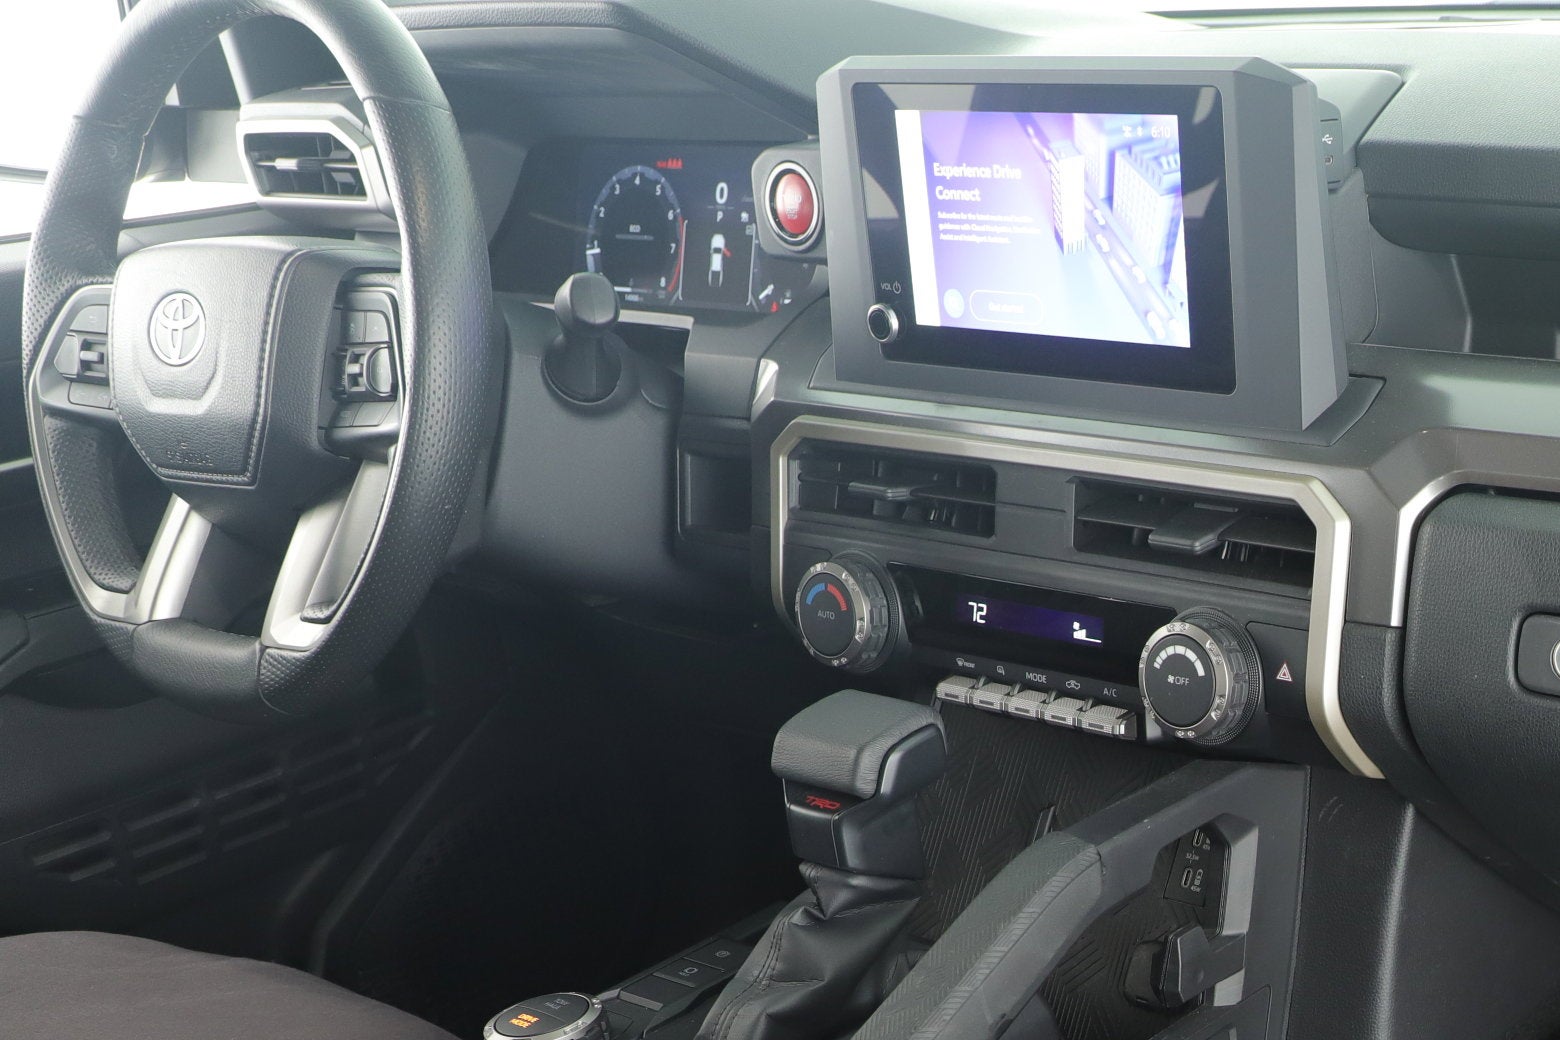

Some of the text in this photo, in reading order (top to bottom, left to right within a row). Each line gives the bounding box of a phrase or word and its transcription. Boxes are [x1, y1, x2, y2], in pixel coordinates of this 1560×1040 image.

[1151, 126, 1171, 138] 6:10
[933, 162, 1022, 180] Experience Drive
[634, 173, 640, 185] 4
[614, 183, 620, 195] 3
[655, 184, 661, 196] 5
[715, 182, 728, 204] 0
[935, 185, 982, 202] Connect
[599, 206, 605, 218] 2
[667, 209, 674, 220] 6
[716, 210, 724, 222] P
[670, 243, 676, 254] 7
[881, 282, 892, 291] VOL
[817, 610, 835, 620] AUTO
[968, 601, 987, 624] 72
[1025, 672, 1047, 684] MODE
[1174, 676, 1190, 686] OFF
[1103, 687, 1118, 698] A/C
[805, 795, 841, 810] TRD
[509, 1018, 532, 1029] MODE
[517, 1013, 540, 1023] DRIVE
